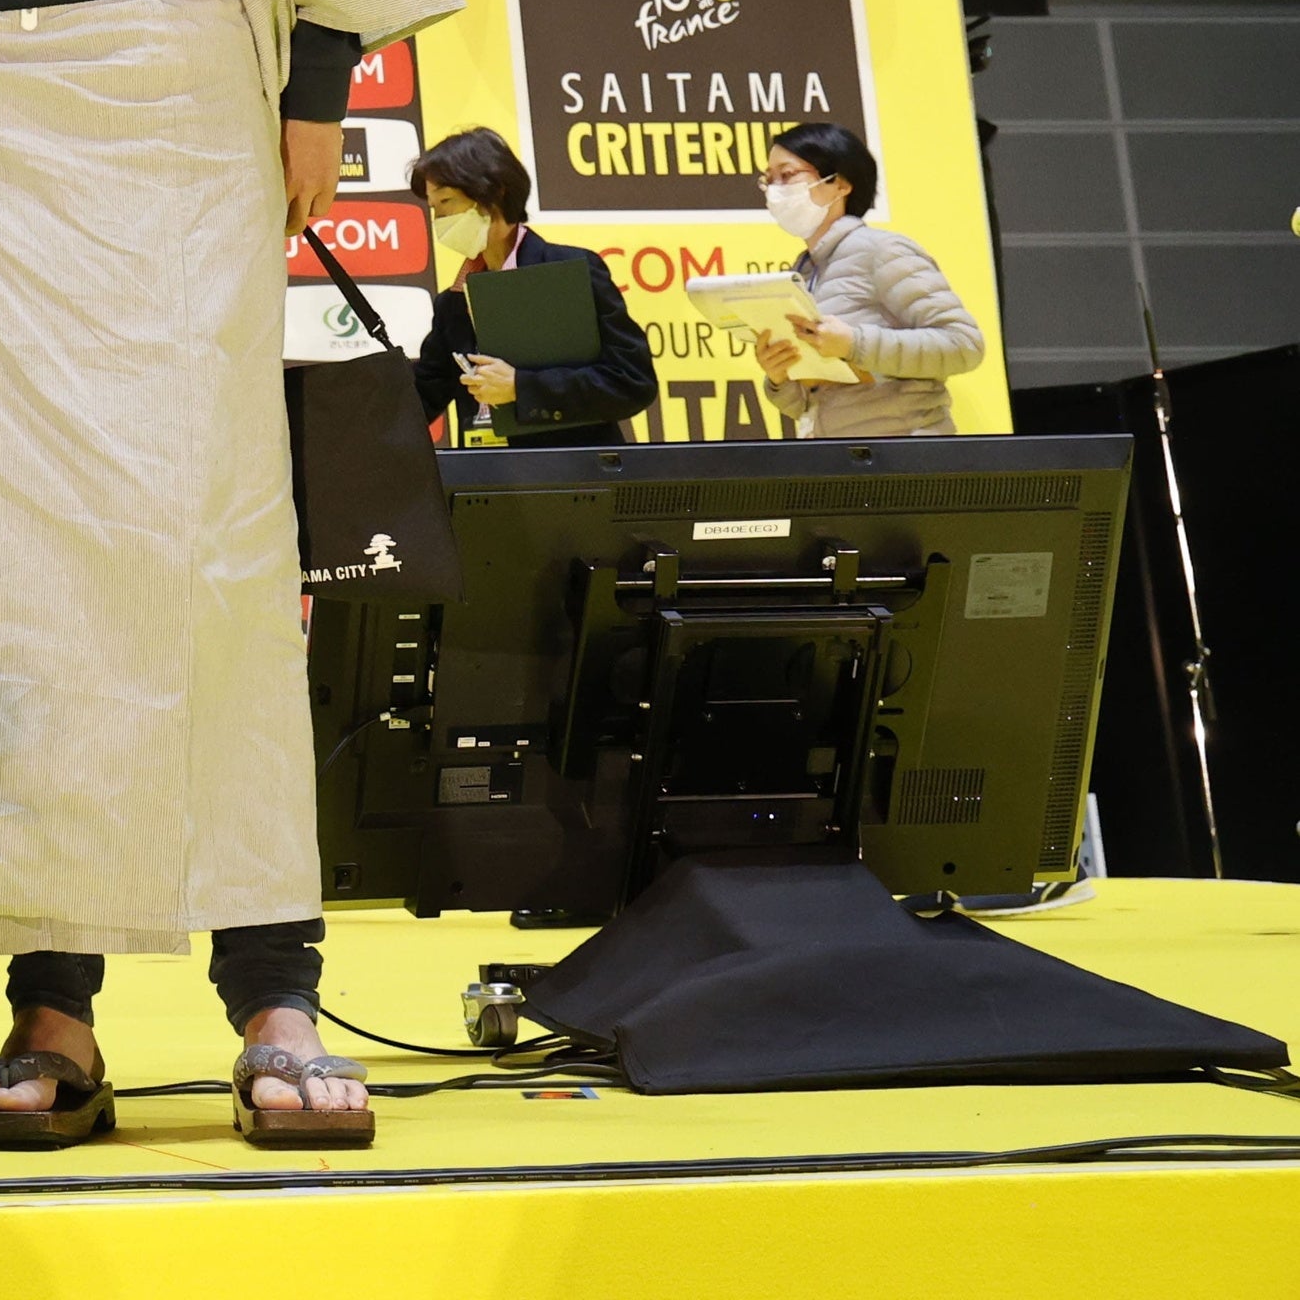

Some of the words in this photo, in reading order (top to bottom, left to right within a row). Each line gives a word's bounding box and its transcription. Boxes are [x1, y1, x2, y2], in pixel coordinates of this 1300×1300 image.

[561, 72, 830, 113] SAITAMA
[567, 122, 800, 176] CRITERIU
[645, 322, 715, 358] OUR
[704, 523, 779, 535] DB40E(EG)
[336, 564, 367, 580] CITY
